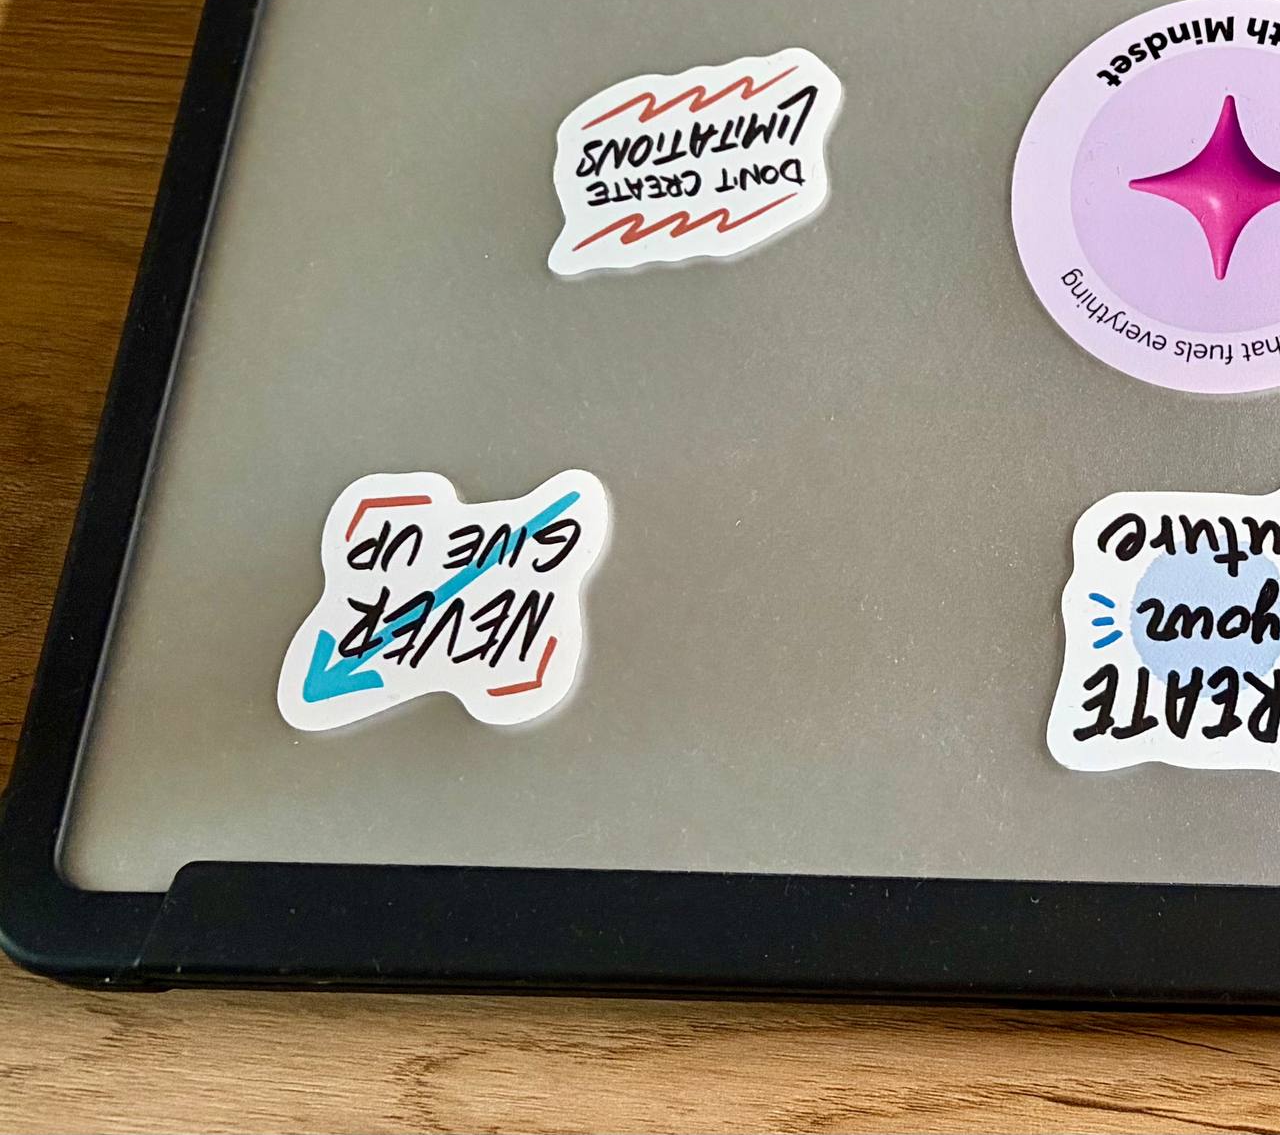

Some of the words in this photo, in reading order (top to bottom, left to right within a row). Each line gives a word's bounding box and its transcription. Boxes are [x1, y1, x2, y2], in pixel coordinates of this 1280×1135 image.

[1096, 16, 1235, 87] Mindset
[576, 85, 818, 177] LIMITATIONS
[586, 170, 701, 206] CREATE
[715, 158, 805, 192] DON'T
[1061, 268, 1167, 351] everything
[1174, 339, 1233, 365] fuels
[347, 520, 423, 572] UP
[442, 518, 581, 573] GIVE
[338, 586, 555, 669] NEVER
[1136, 578, 1280, 644] your
